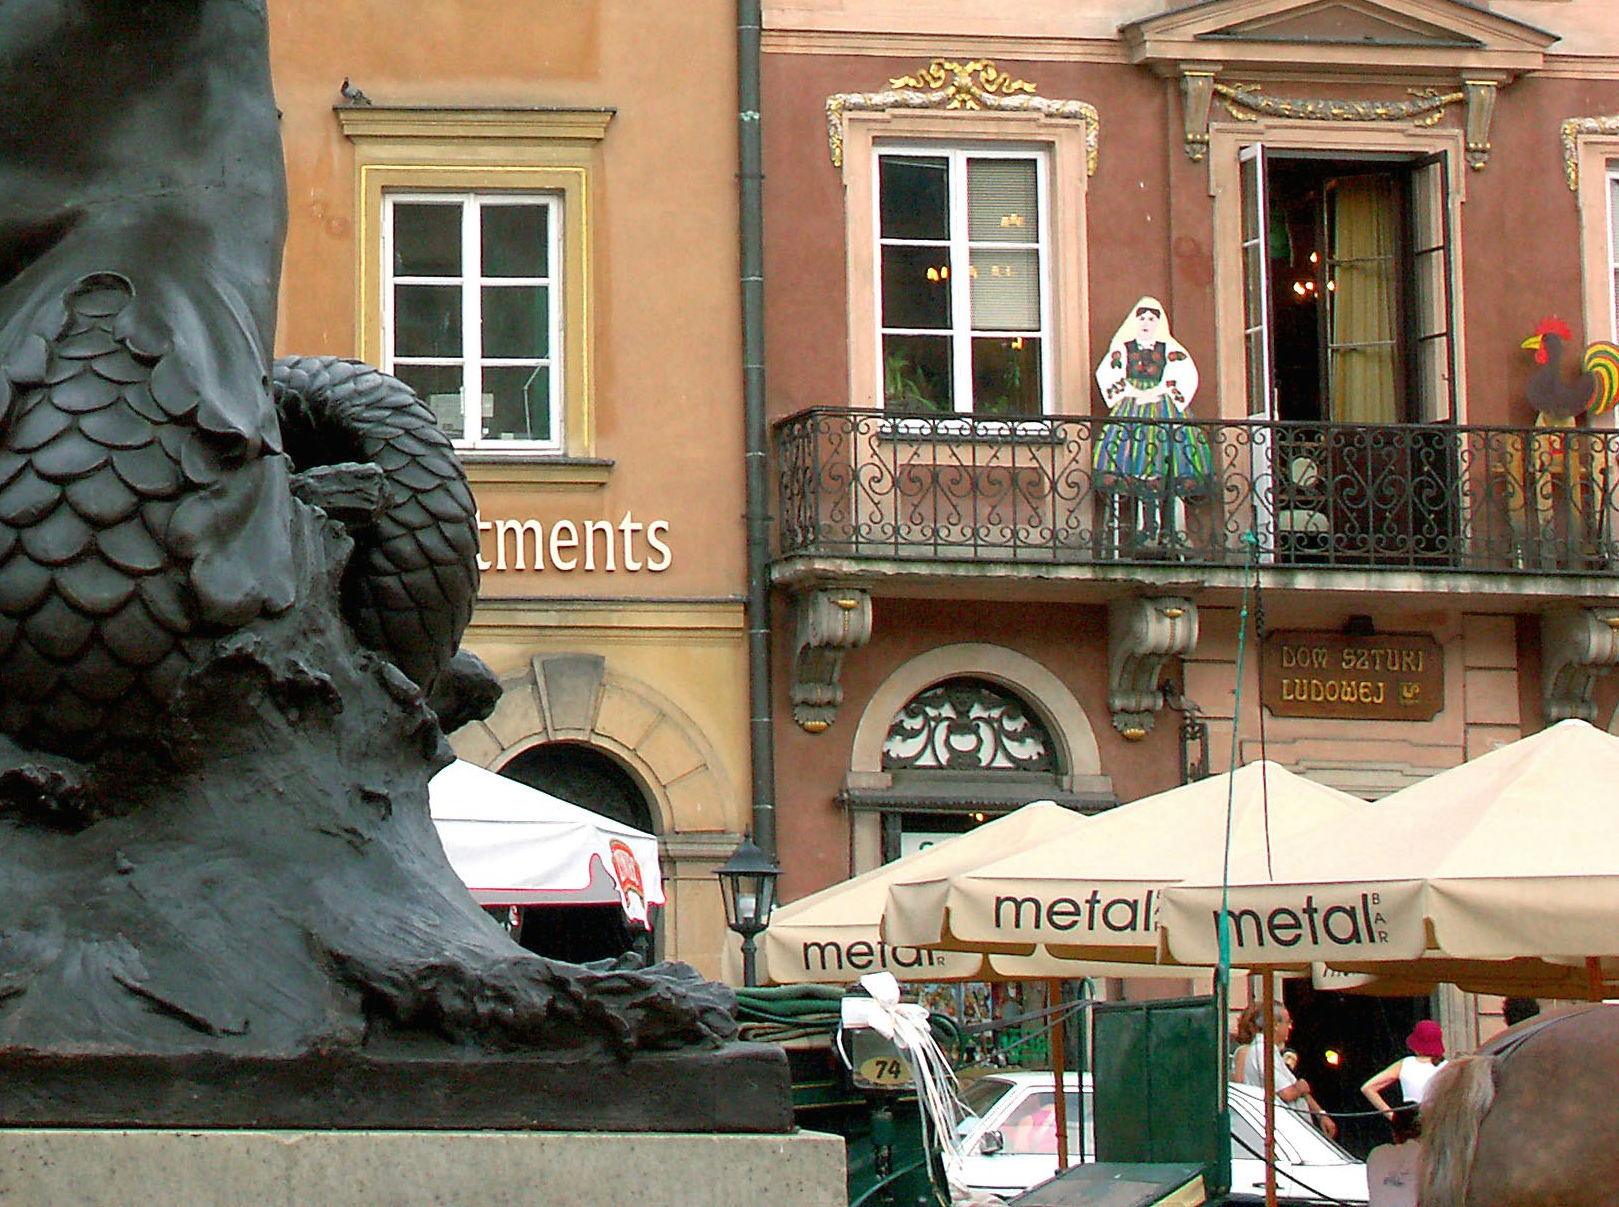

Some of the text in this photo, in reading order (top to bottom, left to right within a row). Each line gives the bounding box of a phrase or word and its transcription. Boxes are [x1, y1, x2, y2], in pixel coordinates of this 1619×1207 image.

[1282, 645, 1424, 673] DOM SZTUKI
[1282, 678, 1385, 705] LUDOWEJ
[994, 889, 1153, 932] metal
[1212, 893, 1376, 947] metal
[875, 1059, 901, 1079] 74
